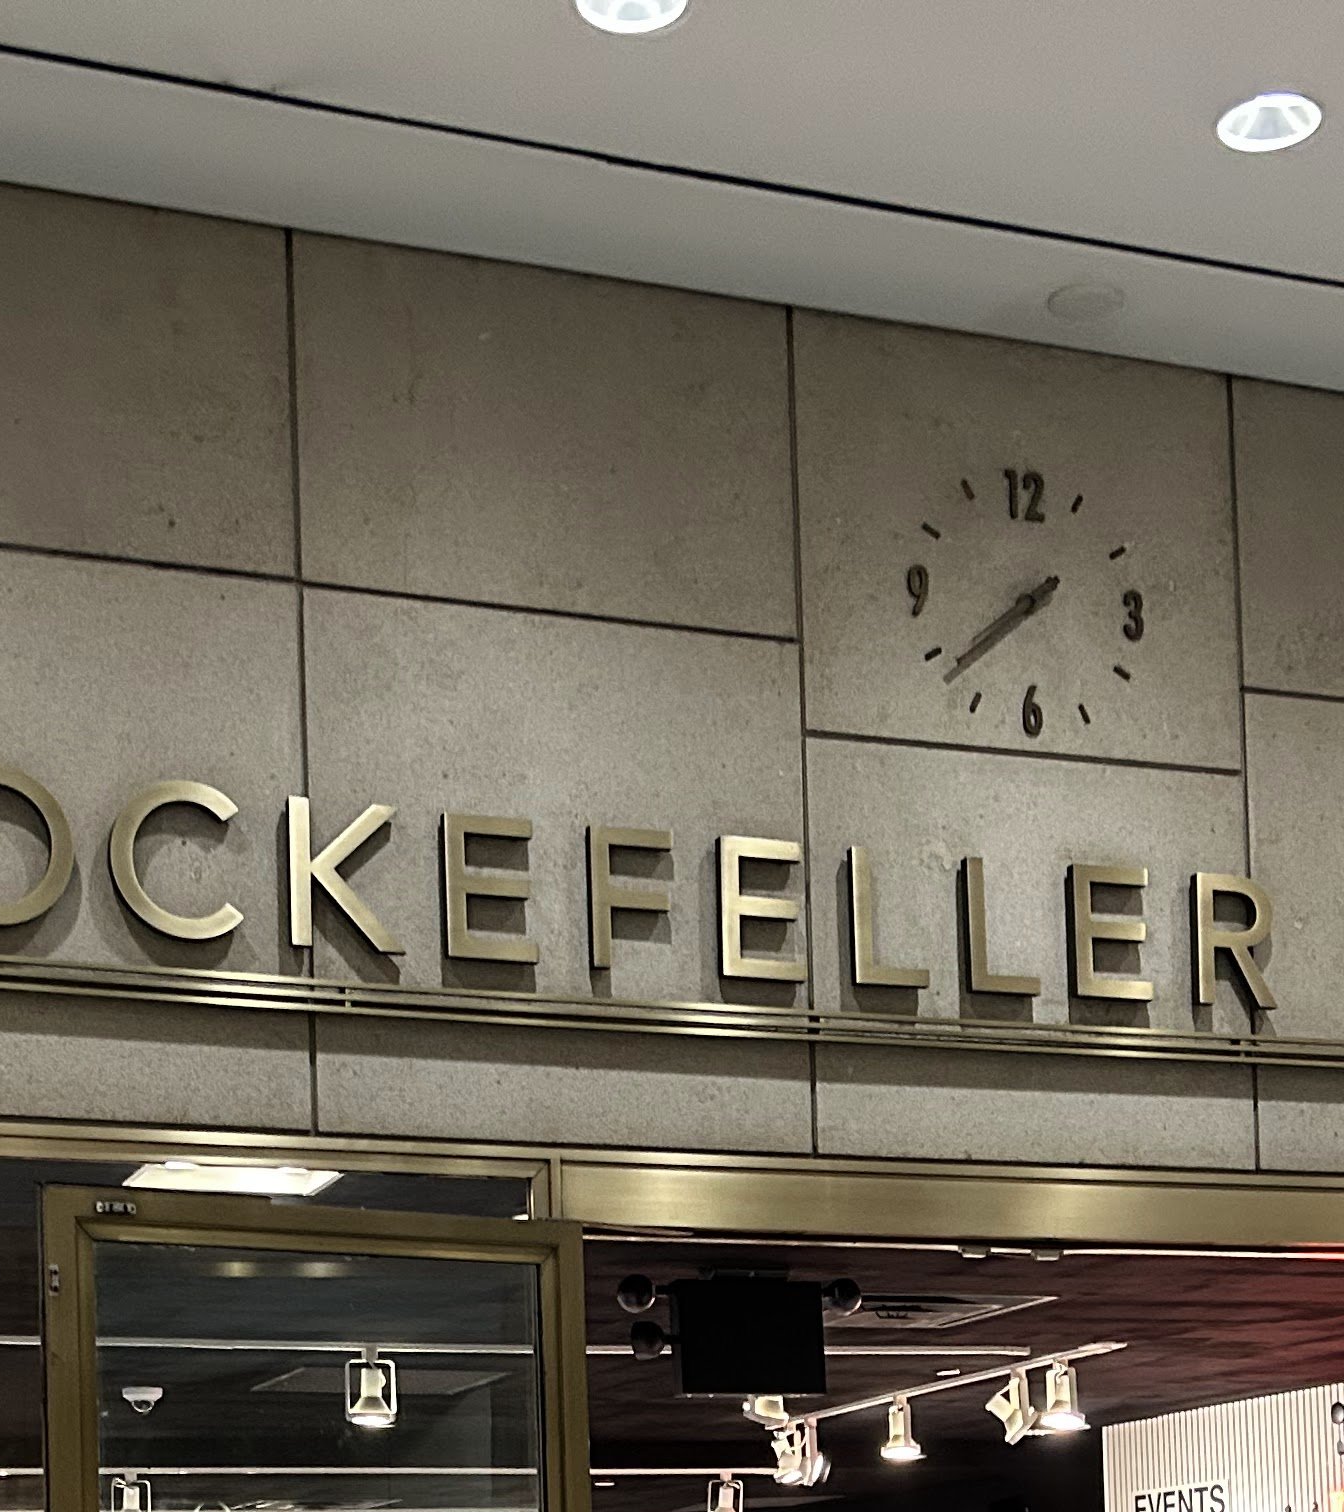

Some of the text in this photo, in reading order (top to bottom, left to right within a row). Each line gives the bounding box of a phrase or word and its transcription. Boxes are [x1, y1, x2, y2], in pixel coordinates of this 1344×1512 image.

[1004, 468, 1046, 523] 12
[906, 563, 929, 617] 9
[1122, 589, 1145, 641] 3
[1021, 684, 1043, 737] 6
